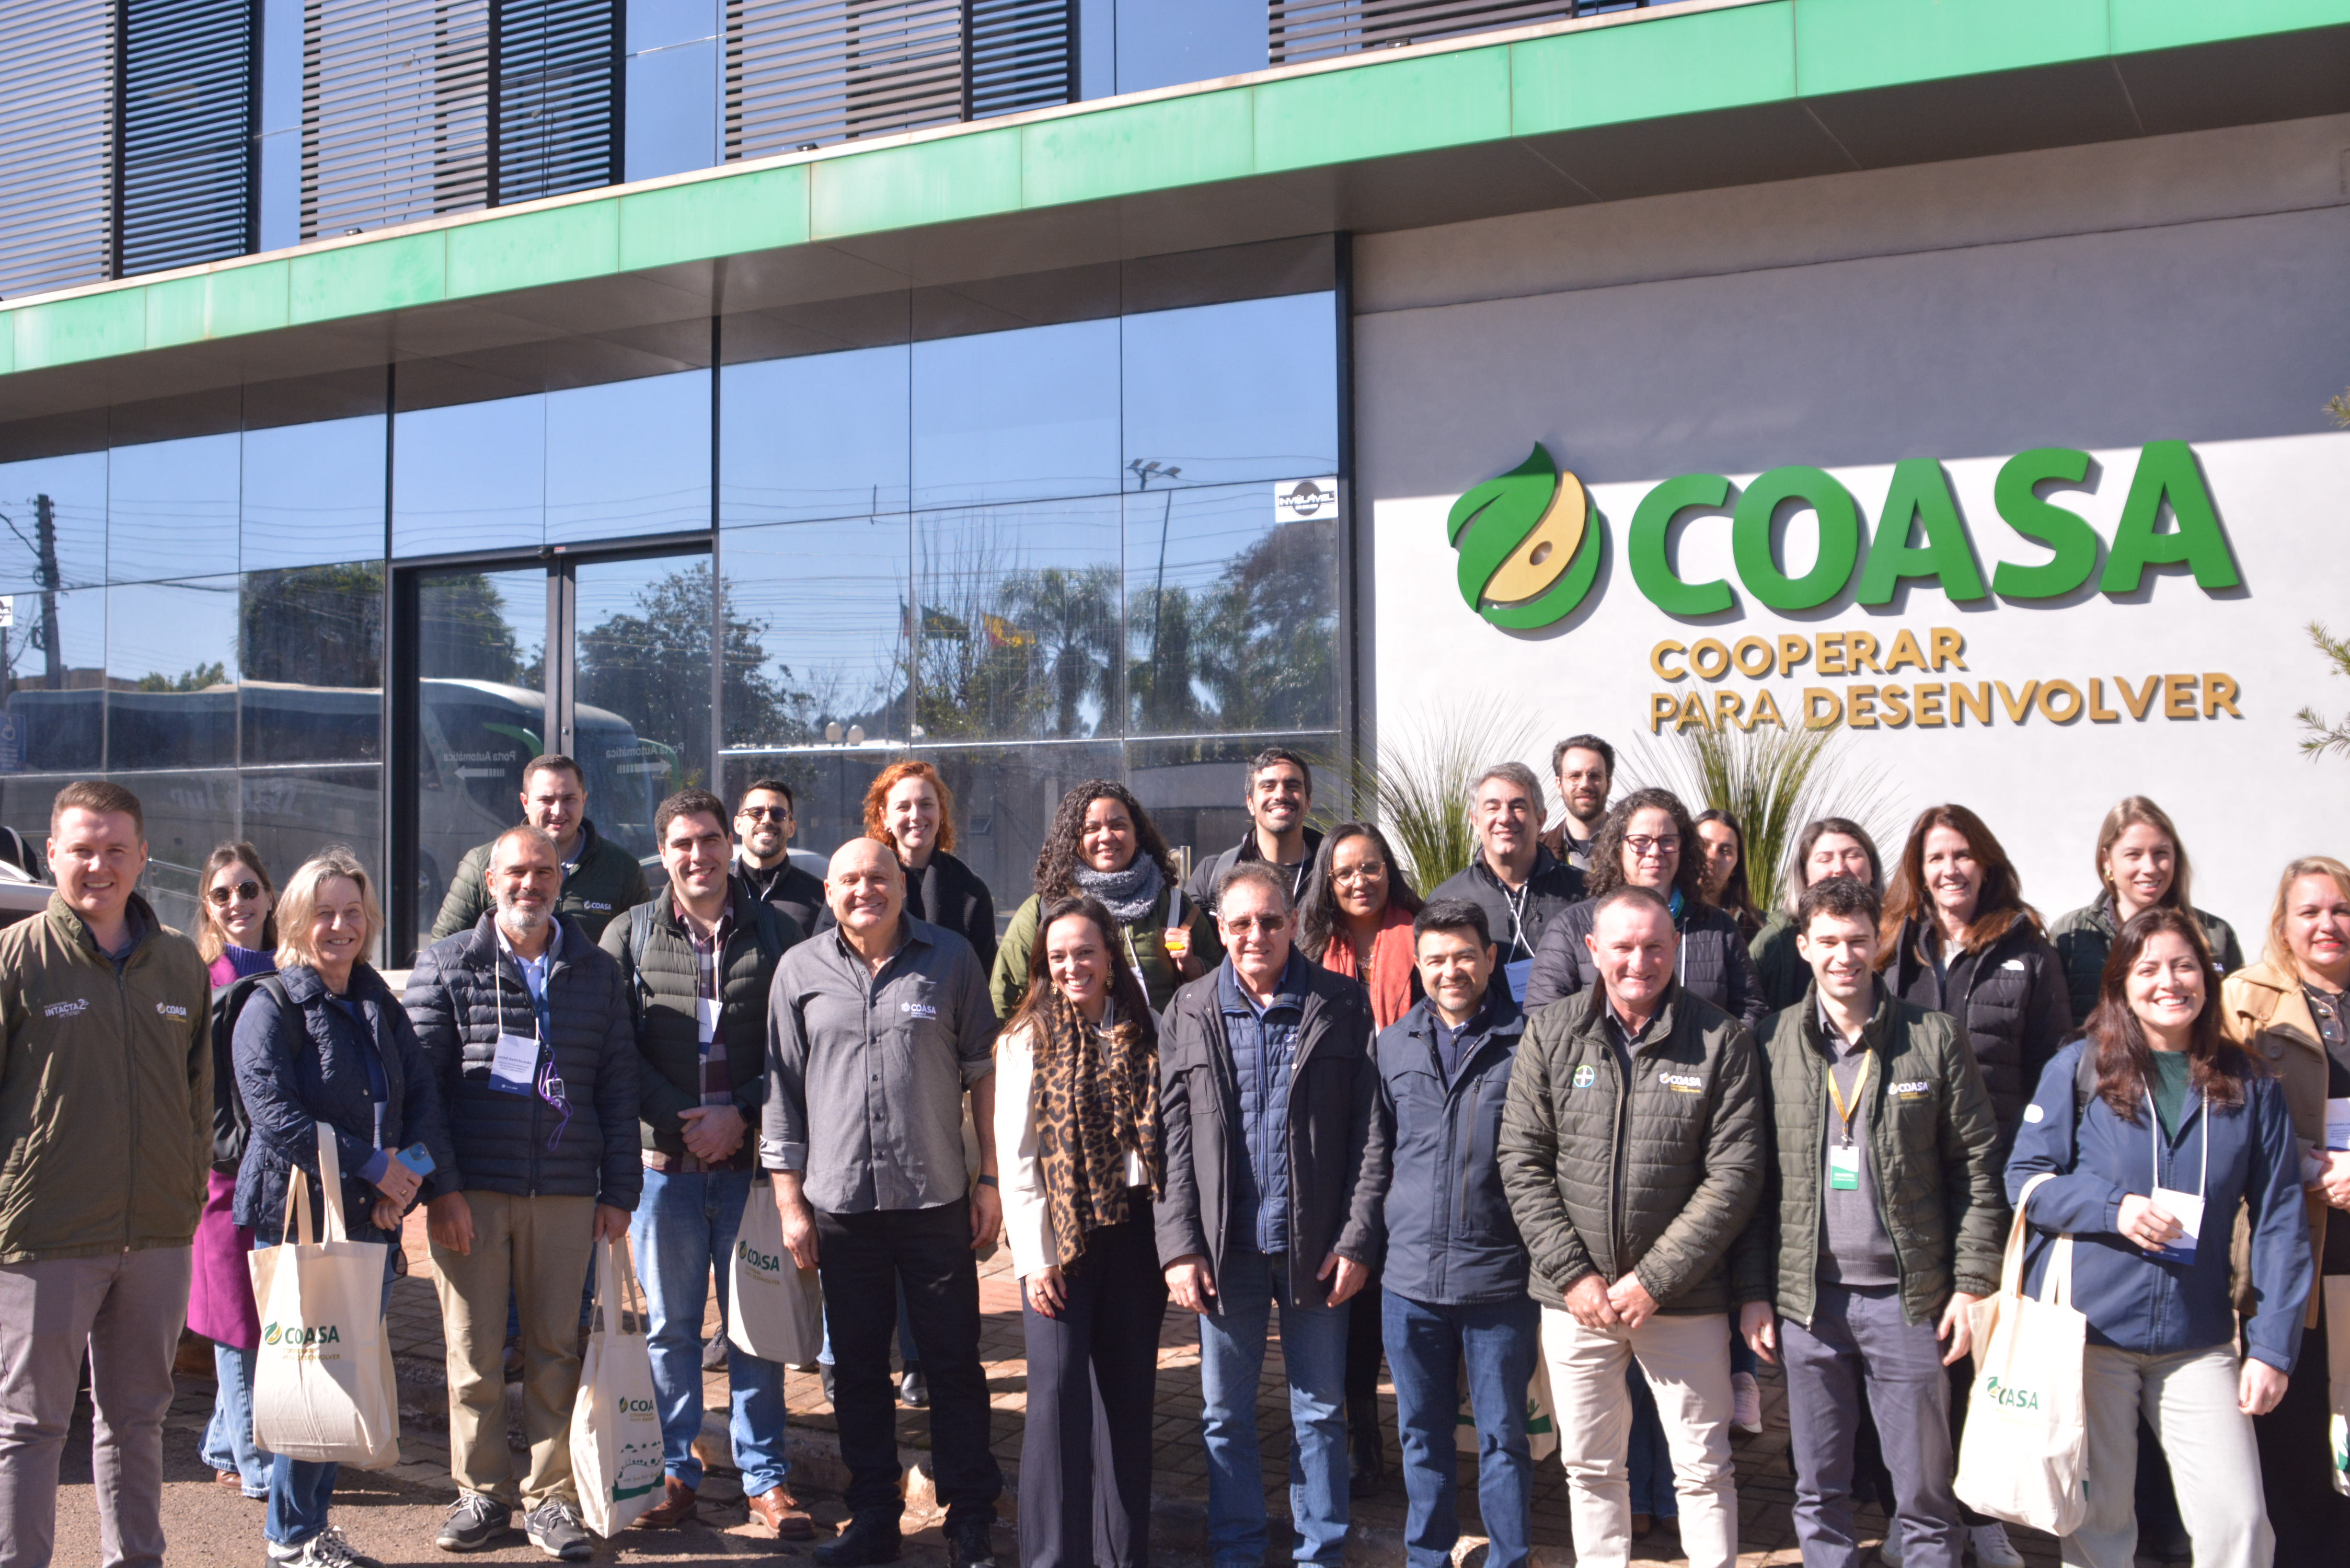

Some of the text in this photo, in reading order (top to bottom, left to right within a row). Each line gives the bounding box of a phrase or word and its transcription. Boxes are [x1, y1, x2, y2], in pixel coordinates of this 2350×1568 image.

[1628, 440, 2239, 615] COASA
[1650, 627, 1967, 679] COOPERAR
[1651, 673, 2242, 732] PARA DESENVOLVER
[166, 1005, 187, 1016] COASA
[911, 1004, 936, 1014] COASA
[1670, 1075, 1701, 1087] COASA
[1898, 1082, 1929, 1092] COASA
[747, 1248, 779, 1272] COASA
[285, 1325, 340, 1345] COASA
